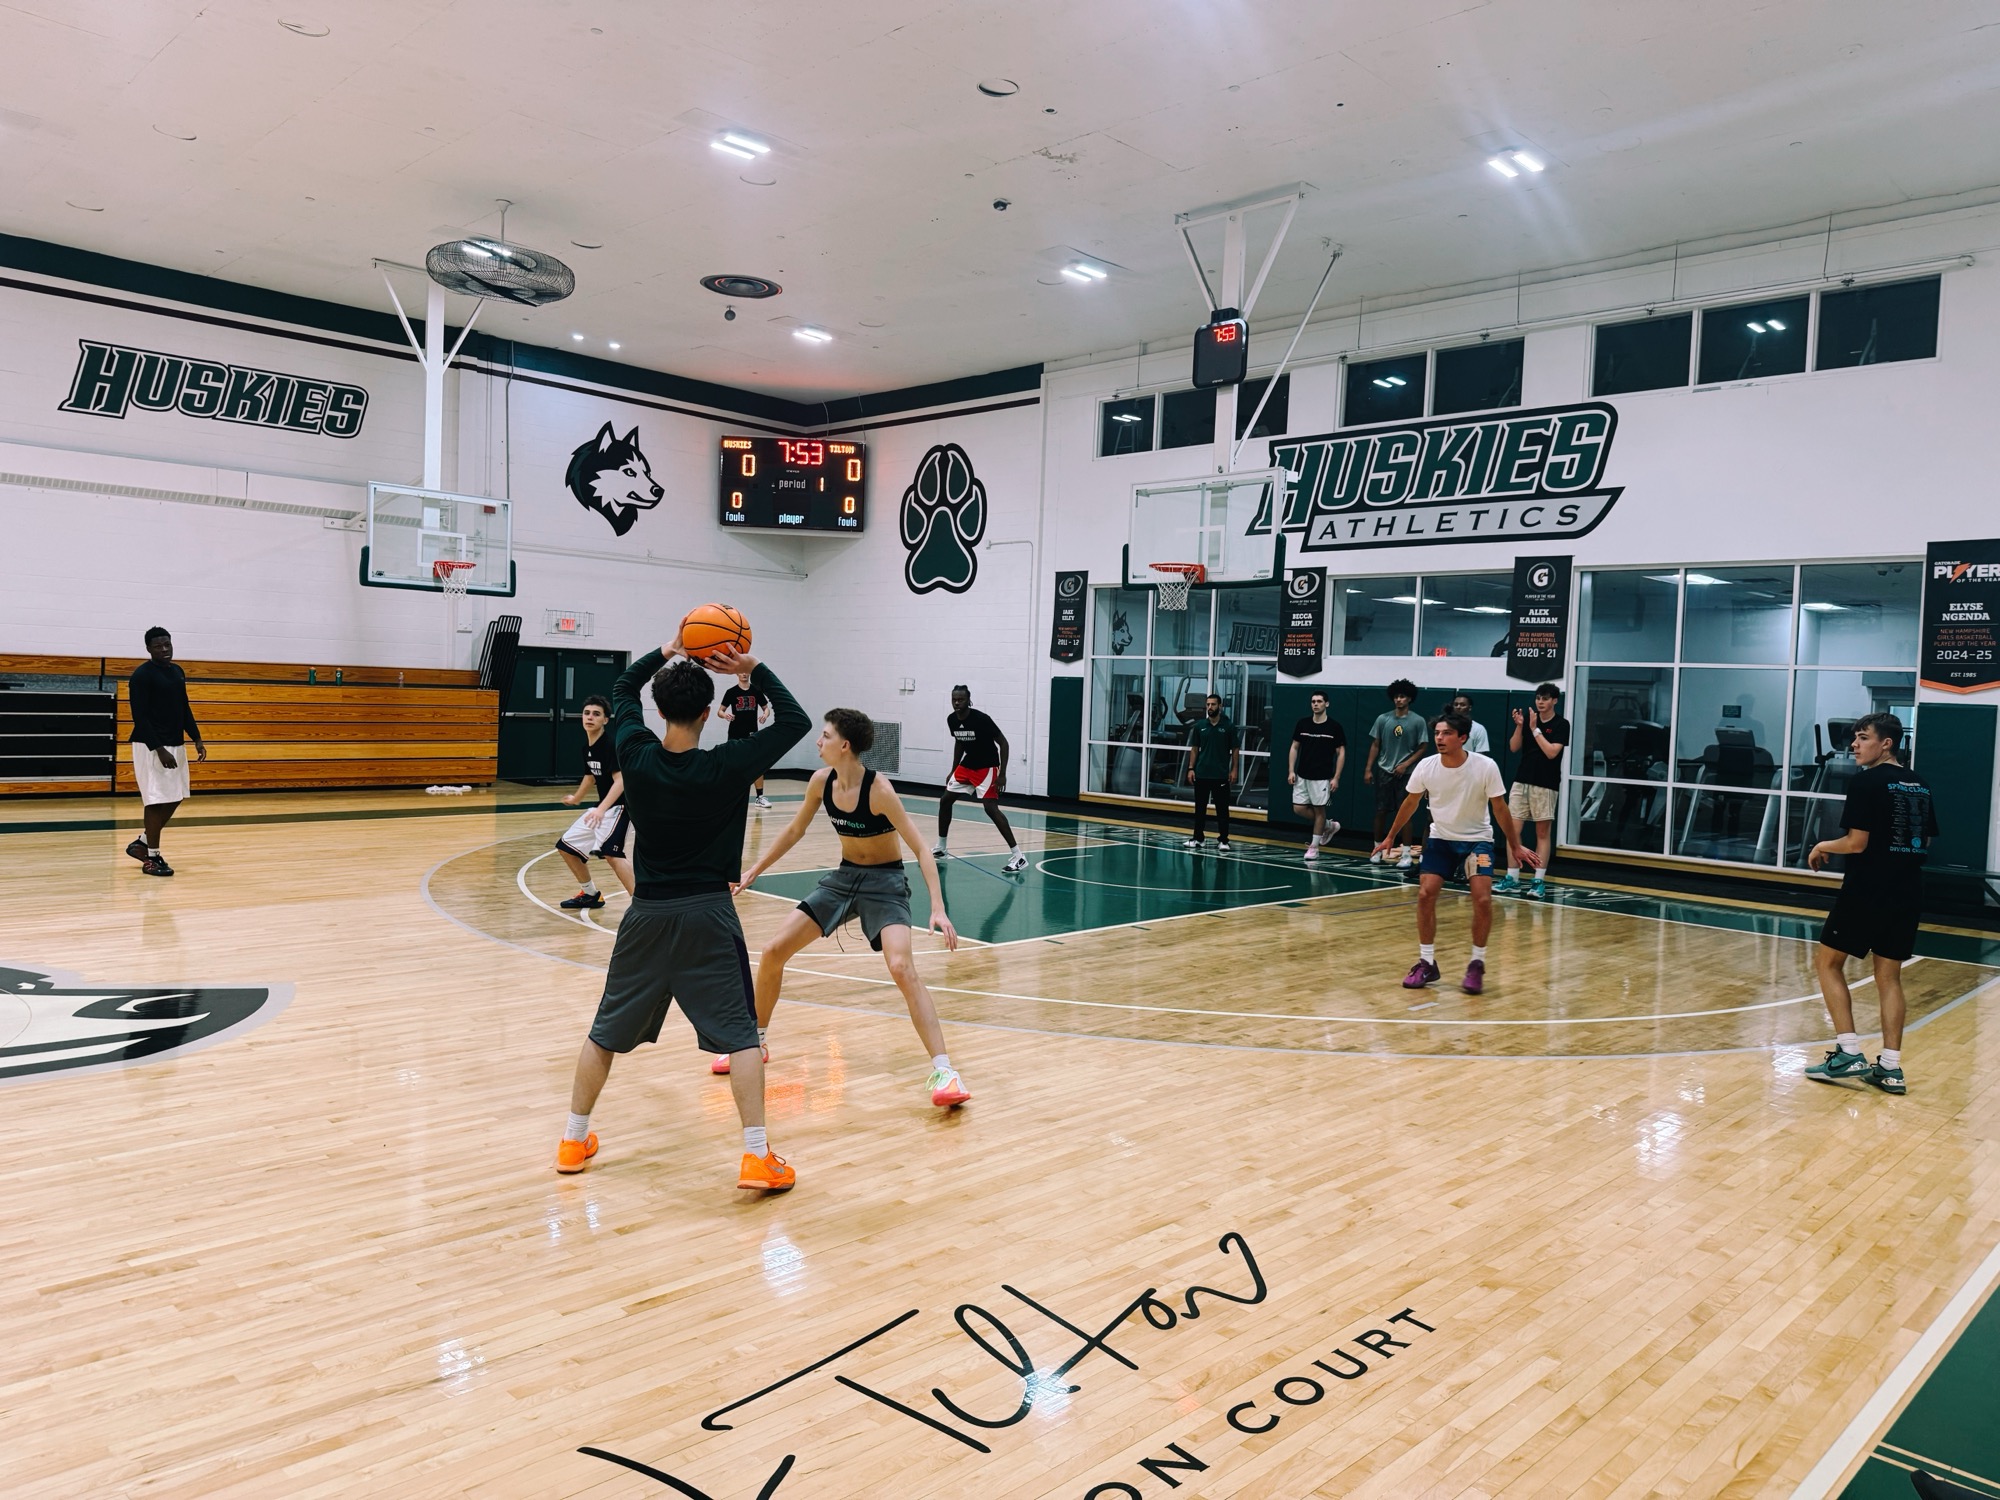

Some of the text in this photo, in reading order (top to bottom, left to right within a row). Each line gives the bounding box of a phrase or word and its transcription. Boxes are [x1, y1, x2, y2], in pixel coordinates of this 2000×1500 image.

[1214, 326, 1236, 342] 7:53
[57, 338, 369, 439] HUSKIES
[724, 440, 752, 449] HUSKIES
[830, 445, 855, 454] TILTON
[778, 441, 823, 465] 7:53
[742, 454, 756, 477] 0
[848, 459, 861, 481] 0
[1247, 402, 1616, 534] HUSKIES
[779, 477, 825, 492] period 1
[732, 492, 743, 509] 0
[845, 497, 855, 513] 0
[726, 512, 745, 522] fouls
[779, 513, 805, 525] player
[838, 517, 857, 527] fouls
[1318, 504, 1582, 541] ATHLETICS
[1934, 563, 2000, 579] PLYER
[1949, 603, 1983, 611] ELYSE
[1942, 613, 1991, 621] NGENDA
[1229, 622, 1279, 653] HUSK
[1284, 648, 1301, 656] 2015
[1307, 648, 1315, 656] 16
[1517, 648, 1539, 658] 2020
[1547, 649, 1556, 658] 21
[1937, 650, 1992, 660] 2024-25
[1226, 1307, 1436, 1434] COURT
